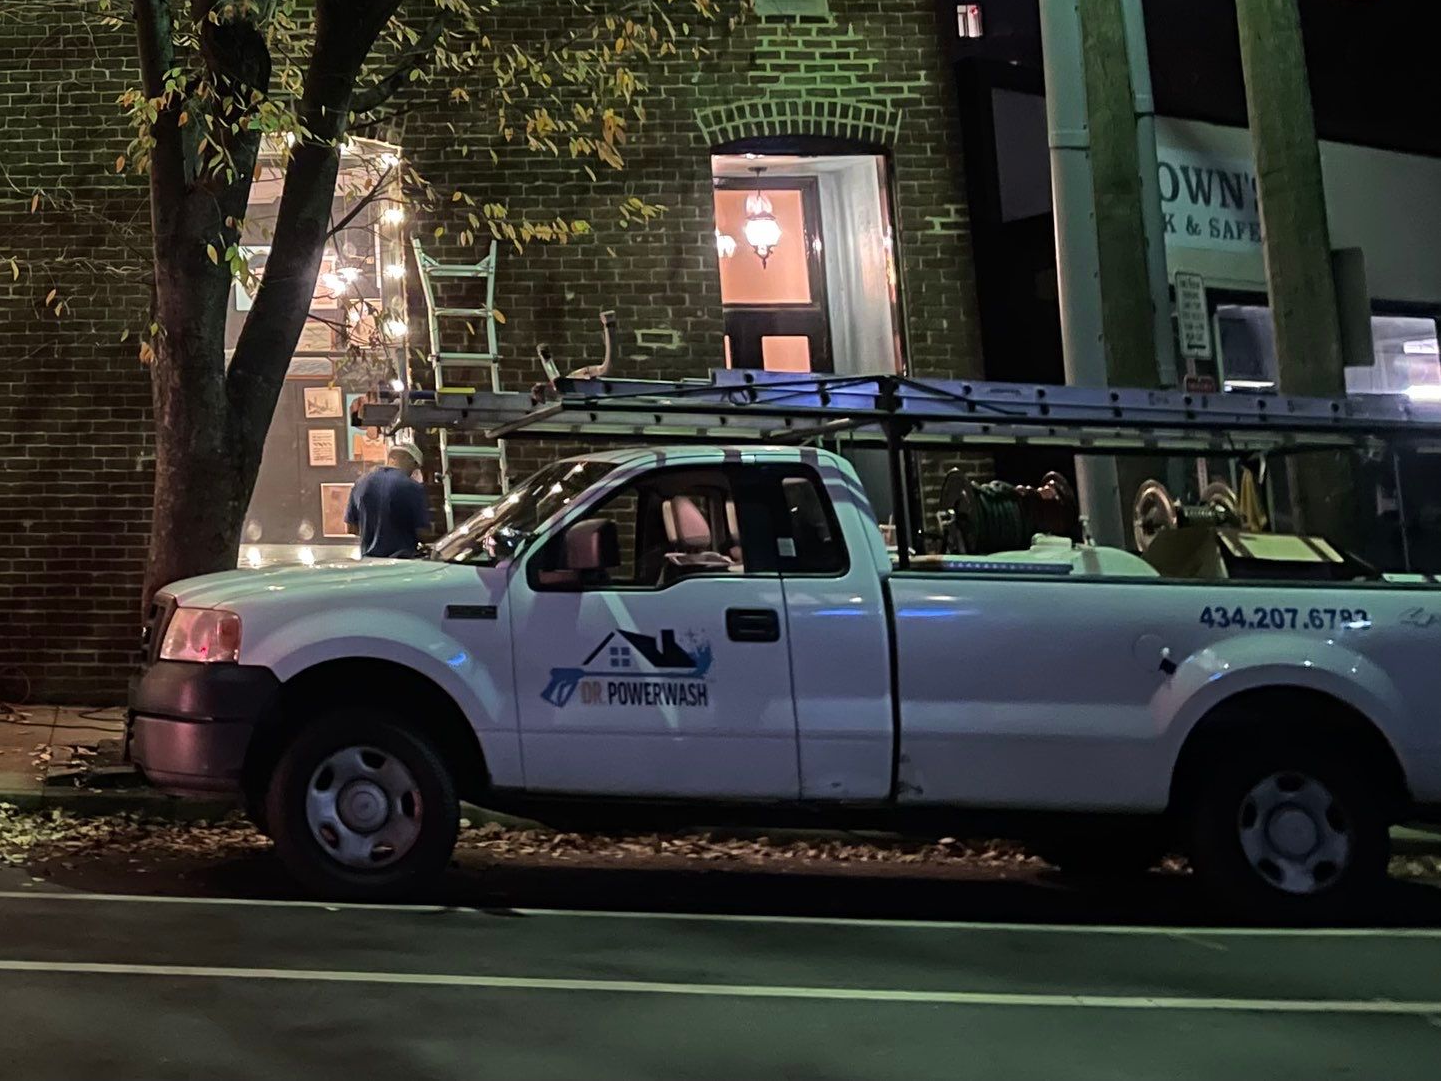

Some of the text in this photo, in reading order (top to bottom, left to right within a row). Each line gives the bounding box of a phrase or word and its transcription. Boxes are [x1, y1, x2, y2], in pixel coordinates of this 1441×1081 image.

[1186, 215, 1202, 236] &
[1208, 217, 1261, 242] SAFE
[607, 682, 709, 707] POWERWASH
